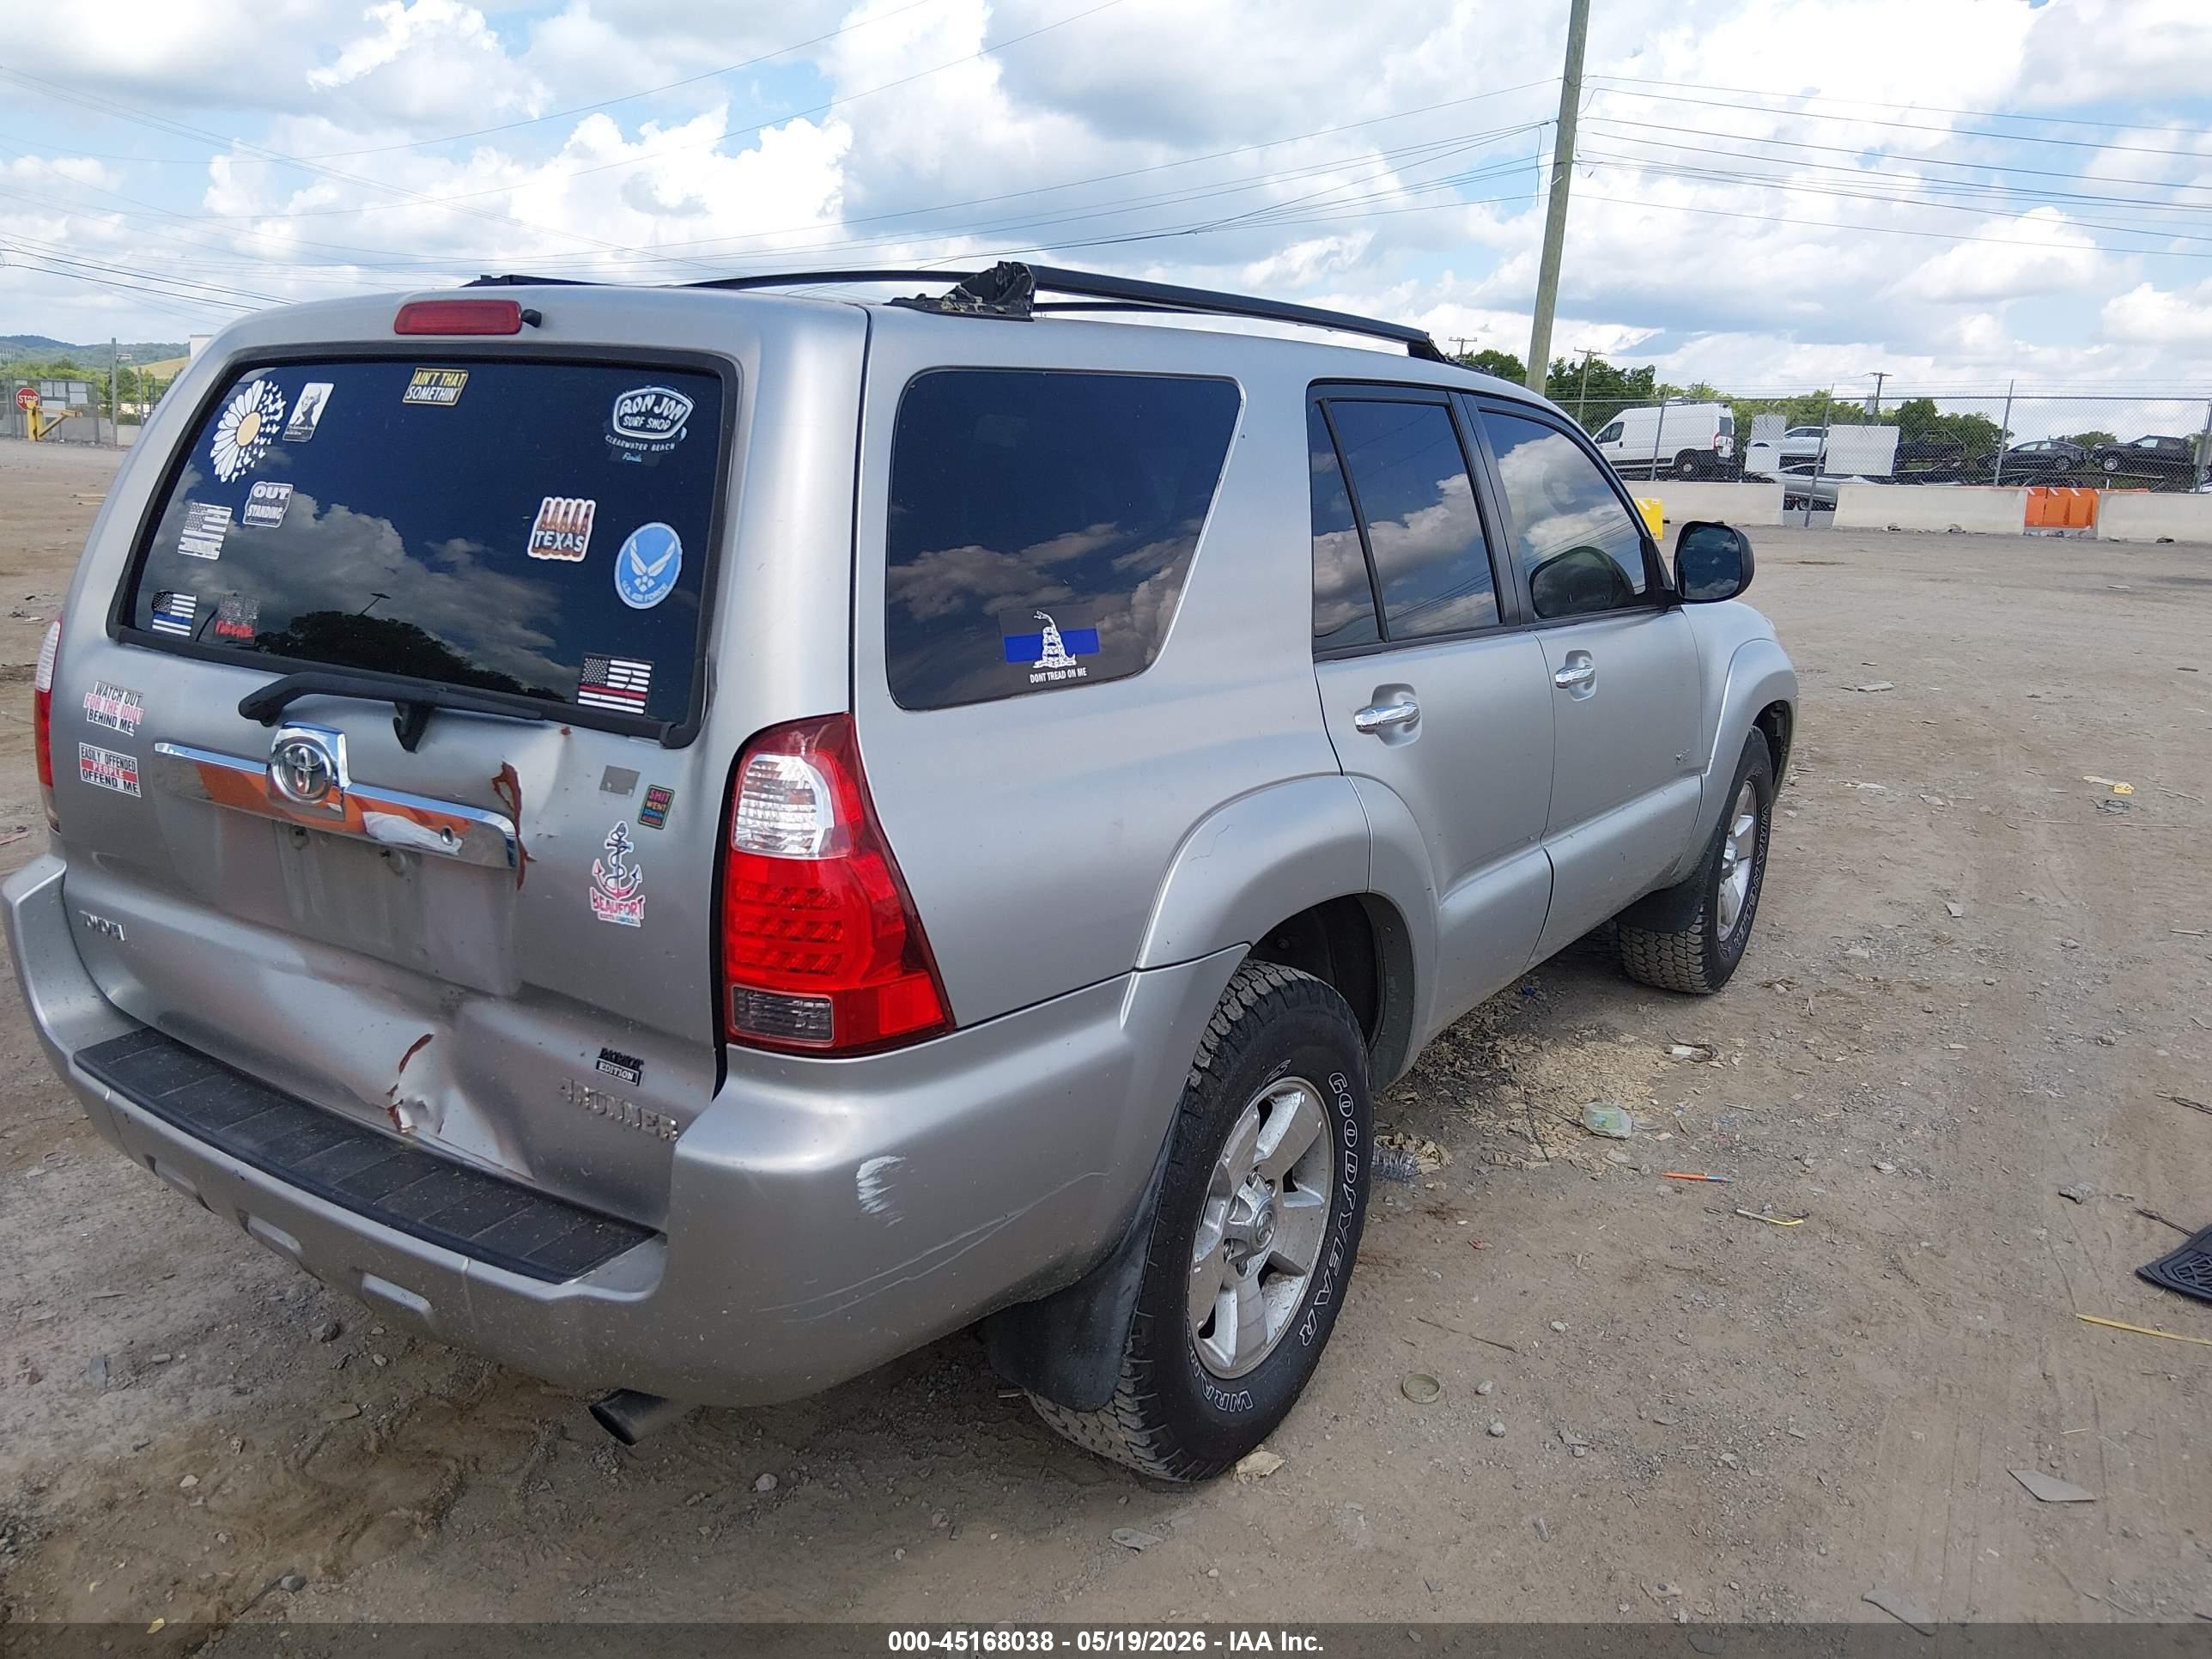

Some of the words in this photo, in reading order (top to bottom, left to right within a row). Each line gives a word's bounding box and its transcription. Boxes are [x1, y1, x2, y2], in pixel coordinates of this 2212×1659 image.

[413, 371, 440, 386] AIN'T
[440, 372, 466, 387] THAT
[619, 394, 656, 416] RON
[653, 397, 686, 421] JON
[623, 416, 646, 428] SURF
[647, 416, 672, 430] SHOP
[605, 434, 648, 451] CLEARWATER
[651, 443, 675, 452] BEACH
[253, 485, 290, 500] OUT
[247, 504, 283, 520] STANDING
[534, 531, 585, 552] TEXAS
[631, 592, 644, 602] AIR
[644, 583, 668, 602] FORCE
[1030, 673, 1047, 684] DONT
[1047, 671, 1066, 682] TREAD
[1067, 669, 1077, 678] ON
[1077, 667, 1088, 678] ME
[95, 683, 125, 702] WATCH
[125, 692, 143, 707] OUT
[85, 694, 102, 710] FOR
[103, 699, 119, 715] THE
[121, 704, 143, 723] IDIOT
[88, 708, 118, 728] BEHIND
[82, 747, 100, 763] EASILY
[104, 753, 136, 773] OFFENDED
[93, 762, 125, 780] PEOPLE
[82, 769, 118, 787] OFFEND
[124, 780, 138, 793] ME
[648, 789, 671, 804] SHIT
[592, 889, 644, 920] BEAUFORT
[599, 1062, 634, 1080] EDITION
[1298, 1072, 1359, 1347] GOODYEAR
